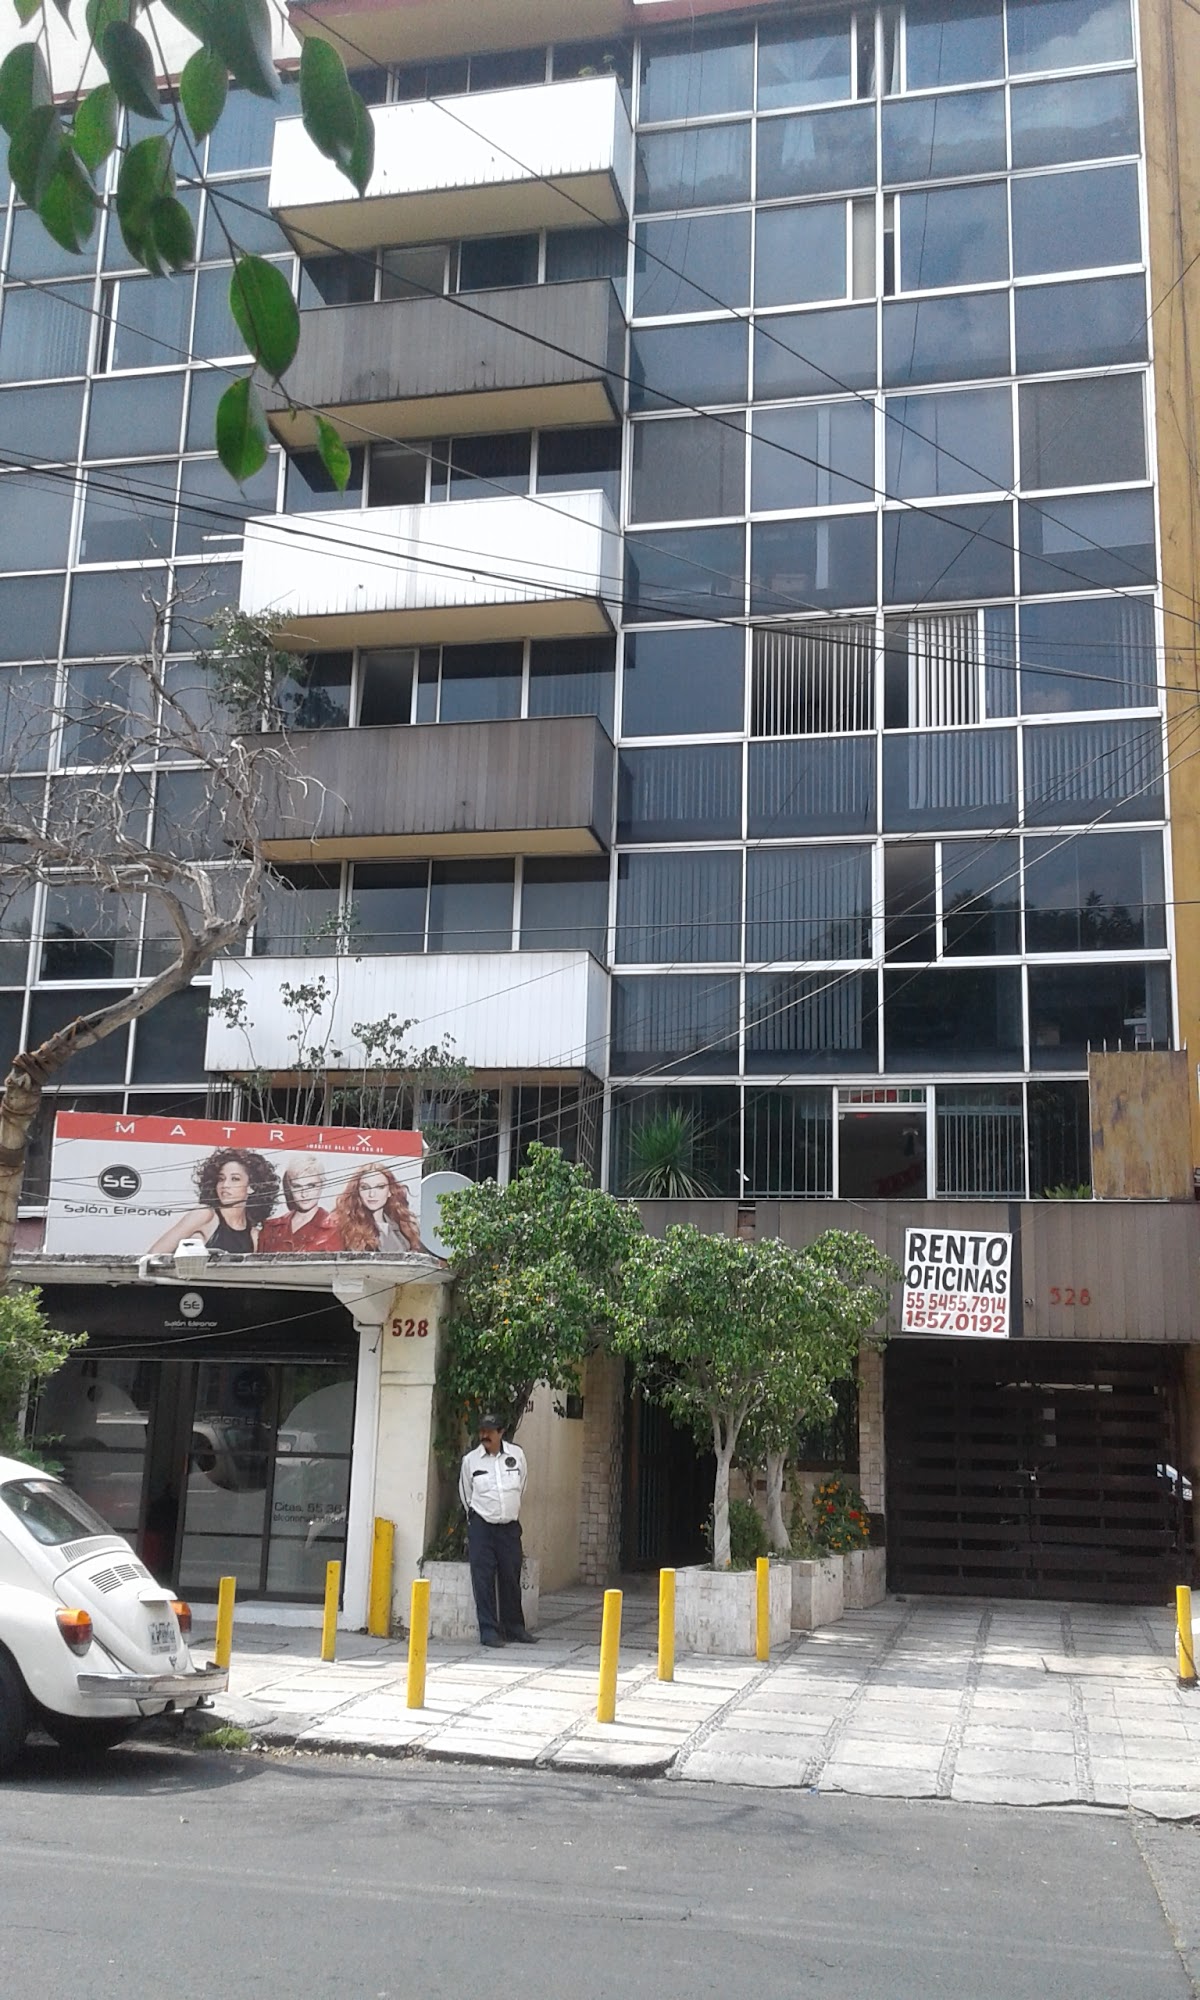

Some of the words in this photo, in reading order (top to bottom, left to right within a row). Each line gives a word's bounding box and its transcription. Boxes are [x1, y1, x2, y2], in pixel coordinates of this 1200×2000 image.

[115, 1121, 372, 1147] MATRIX
[103, 1174, 136, 1189] SE
[64, 1204, 108, 1215] Salón
[113, 1206, 173, 1217] Eleonor
[909, 1233, 1008, 1267] RENTO
[907, 1265, 1007, 1294] OFICINAS
[183, 1300, 201, 1310] SE
[906, 1292, 925, 1309] 55
[928, 1294, 1007, 1314] 5455.7914
[1050, 1287, 1092, 1306] 528
[392, 1317, 429, 1338] 528
[905, 1311, 1006, 1333] 1557.0192
